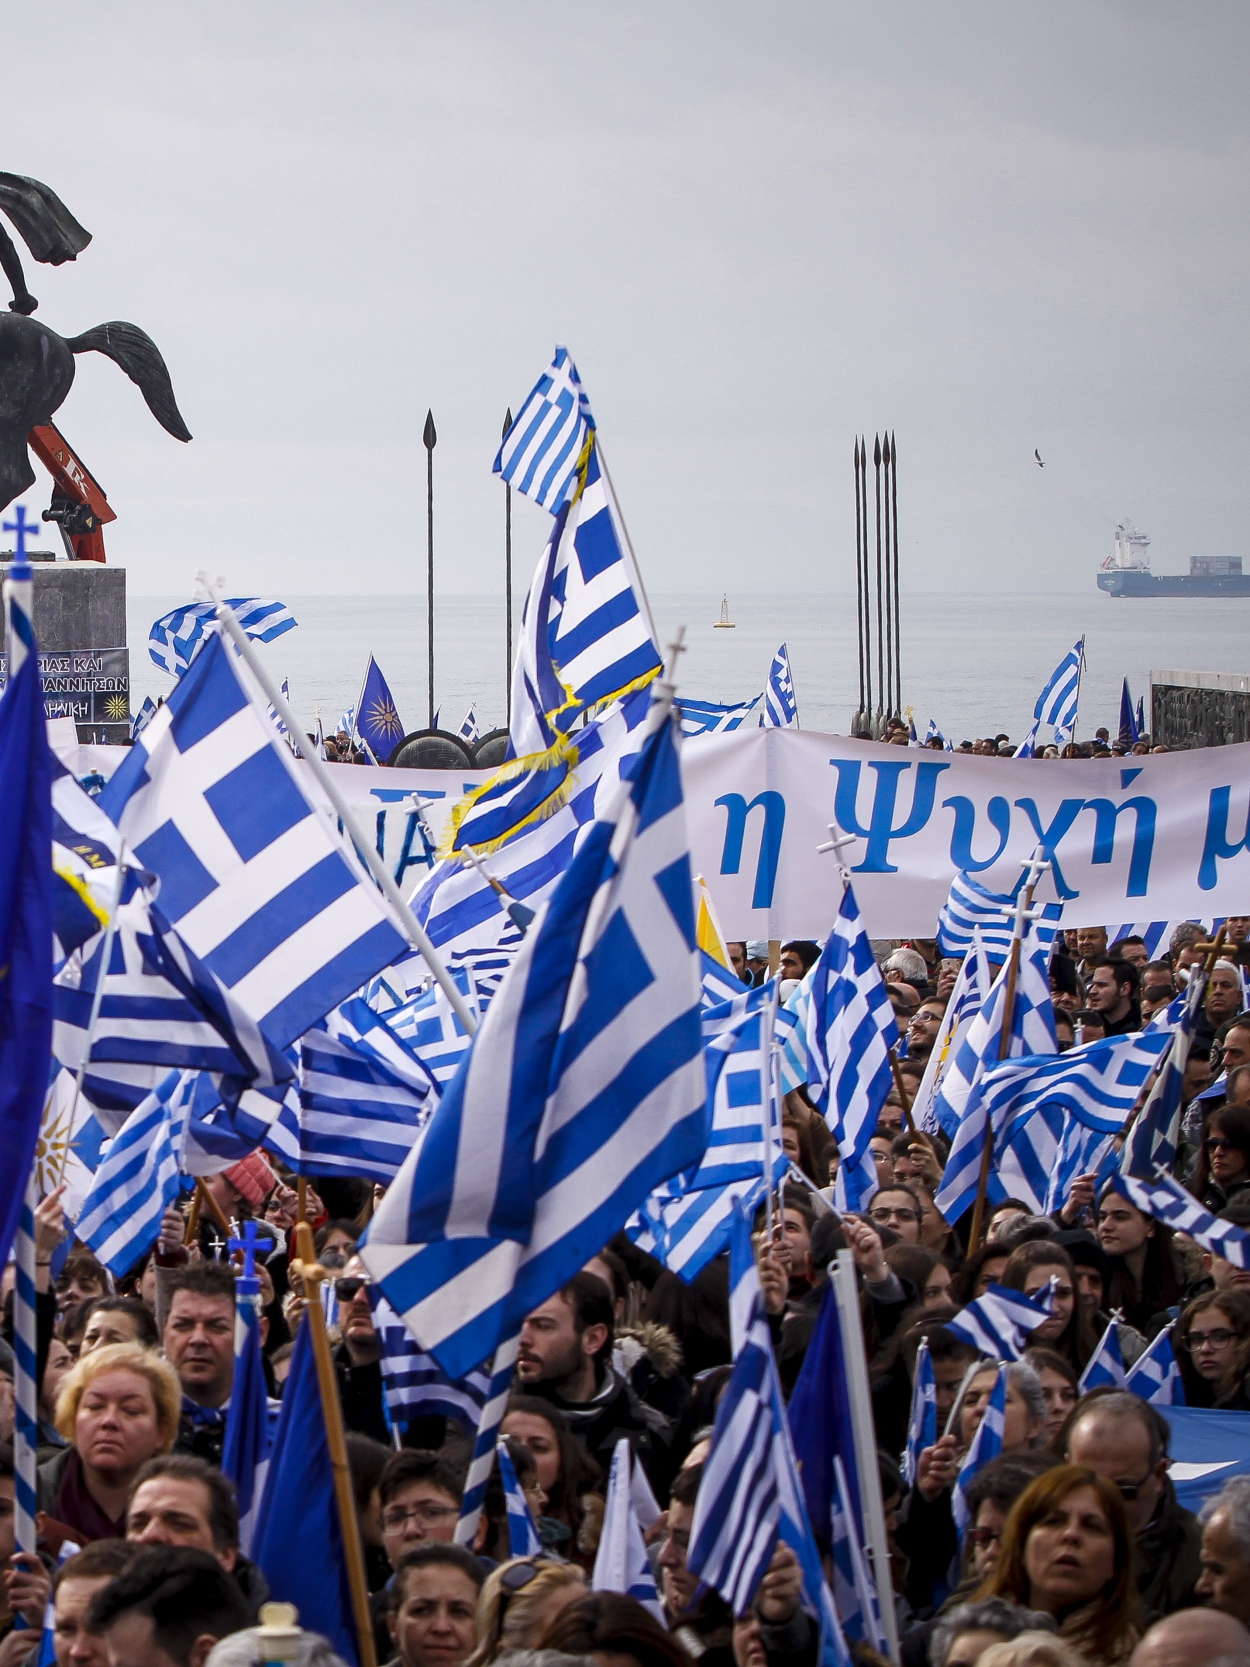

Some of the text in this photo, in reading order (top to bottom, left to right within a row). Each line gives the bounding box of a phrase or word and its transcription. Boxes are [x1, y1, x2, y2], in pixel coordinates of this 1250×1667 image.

[73, 657, 103, 673] ΚΑΙ
[39, 676, 129, 692] ΙΑΝΝΙΤΣΩΝ
[713, 790, 786, 909] η
[829, 758, 1158, 901] Ψυχή
